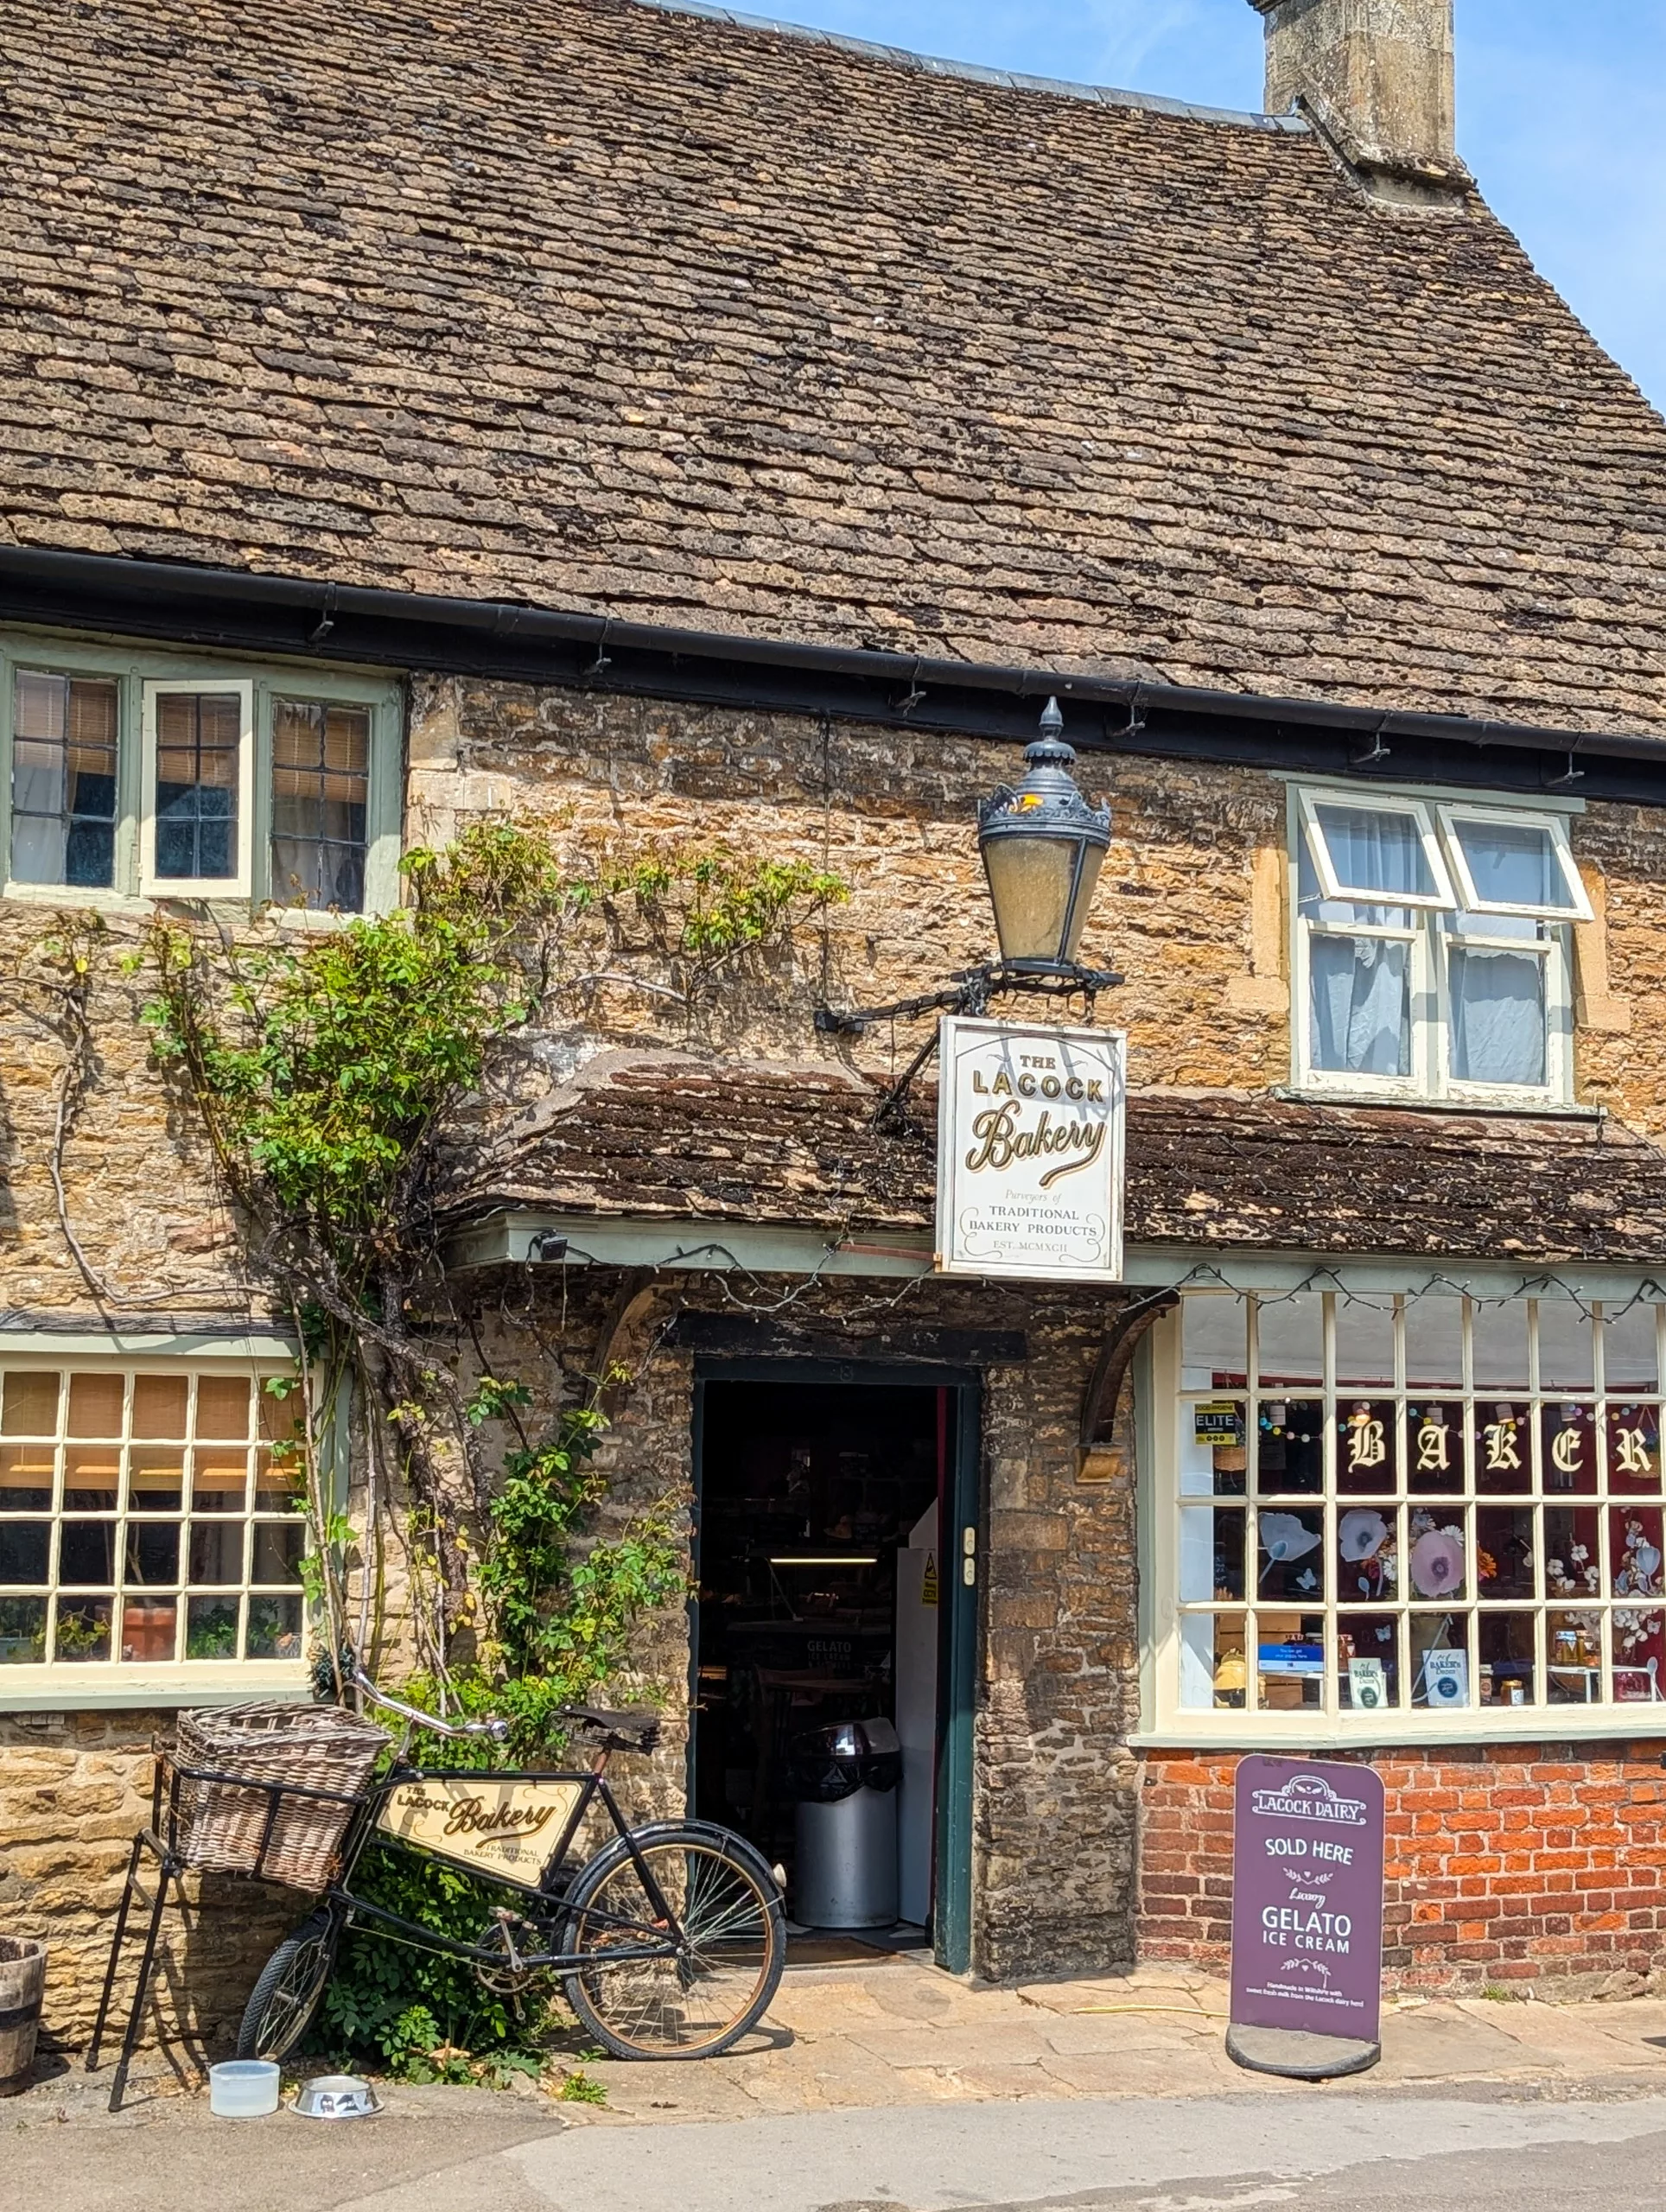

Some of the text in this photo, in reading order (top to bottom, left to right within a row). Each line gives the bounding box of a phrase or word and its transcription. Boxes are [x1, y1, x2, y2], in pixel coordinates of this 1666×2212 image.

[1020, 1054, 1056, 1070] THE
[973, 1071, 1105, 1103] LACOCK
[965, 1099, 1107, 1190] Bakery
[1005, 1189, 1062, 1205] Purveyors of
[989, 1205, 1079, 1220] TRADITIONAL
[970, 1220, 1097, 1236] BAKERY PRODUCTS
[1019, 1242, 1068, 1253] MCMXCII
[1196, 1414, 1234, 1427] ELITE
[1347, 1421, 1653, 1472] BAKER
[807, 1640, 852, 1653] GELATO
[406, 1785, 426, 1796] THE
[397, 1794, 450, 1812] LACOCK
[1258, 1796, 1360, 1820] LACOCK DAIRY
[443, 1795, 558, 1848] Bakery
[463, 1848, 543, 1866] BAKERY PRODUCTS
[486, 1844, 539, 1857] TRADITIONAL
[1265, 1838, 1353, 1866] SOLD HERE
[1288, 1887, 1326, 1910] Luxury
[1262, 1906, 1351, 1937] GELATO
[1262, 1930, 1350, 1955] ICE CREAM
[1267, 1981, 1297, 1992] Handmade
